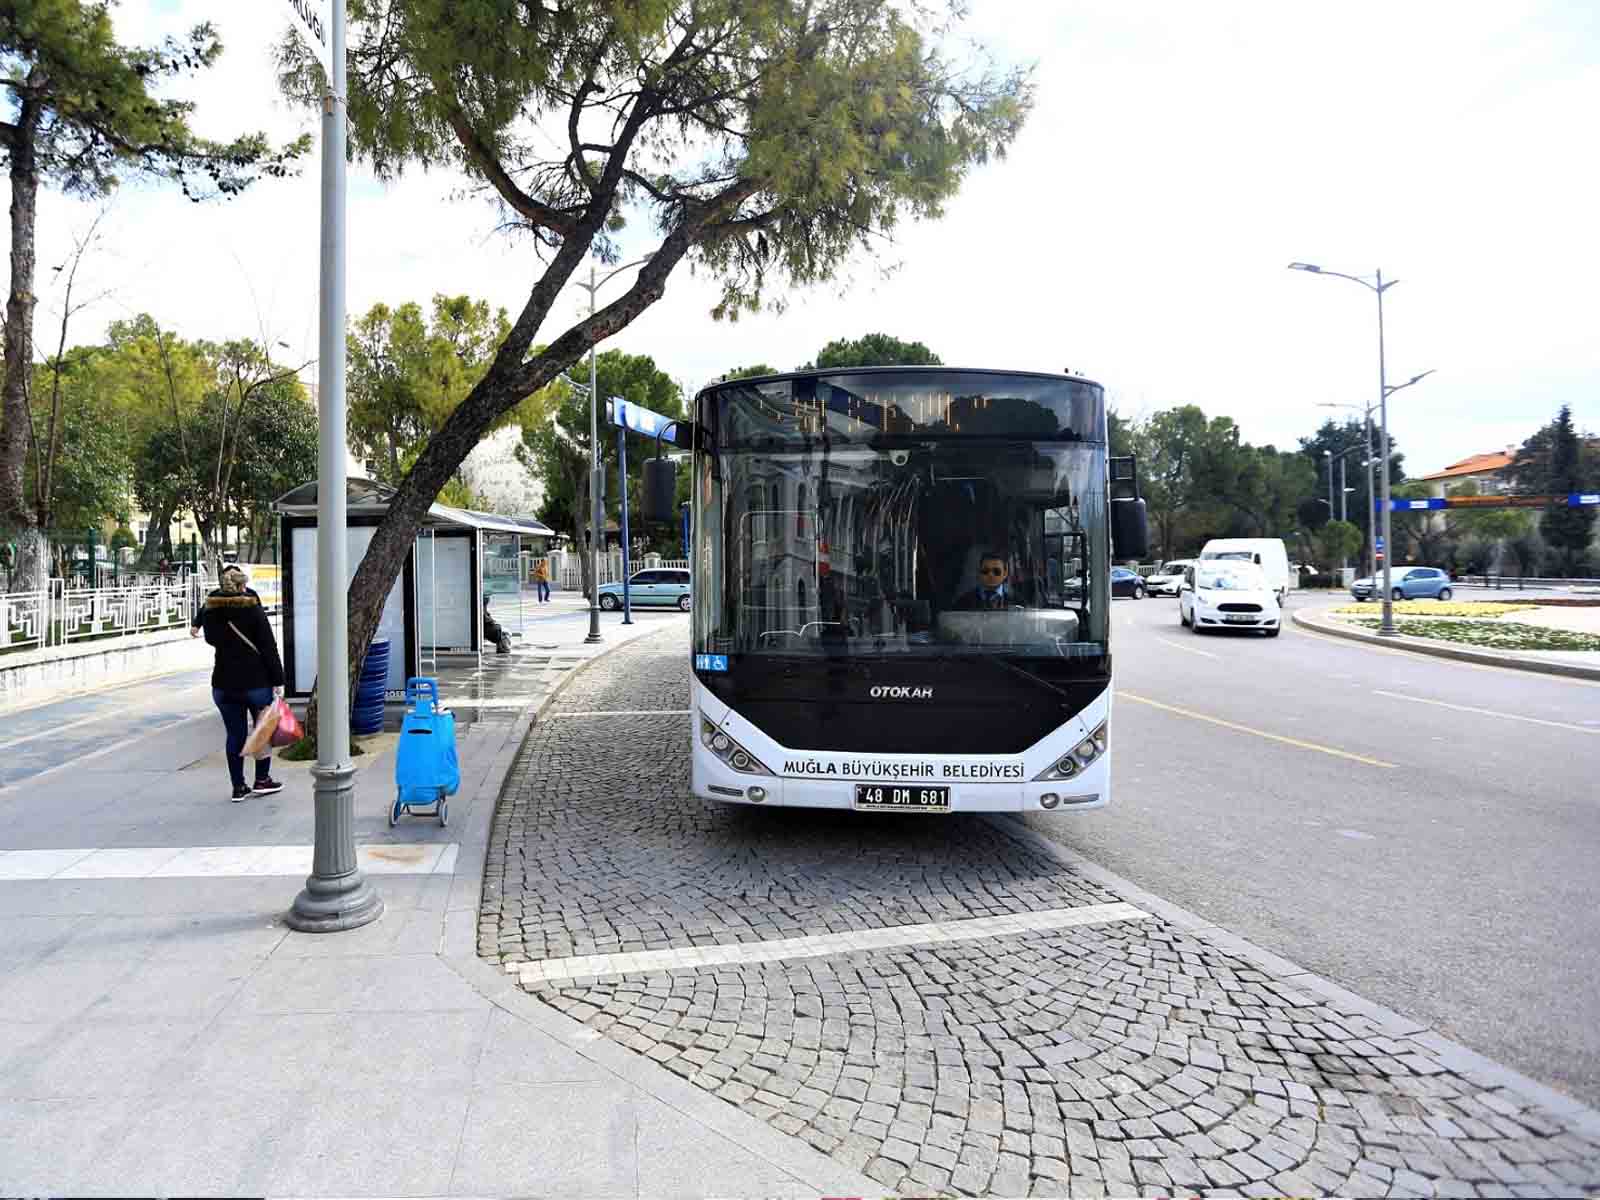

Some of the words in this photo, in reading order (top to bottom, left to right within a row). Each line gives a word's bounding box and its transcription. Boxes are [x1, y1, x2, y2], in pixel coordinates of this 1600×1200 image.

[870, 686, 934, 699] OTOKAR
[783, 759, 837, 774] MUĞLA
[842, 760, 934, 779] BÜYÜKŞEHİR
[943, 762, 1024, 777] BELEDİYESİ
[866, 788, 883, 803] 48
[893, 789, 910, 804] DM
[920, 790, 945, 804] 681
